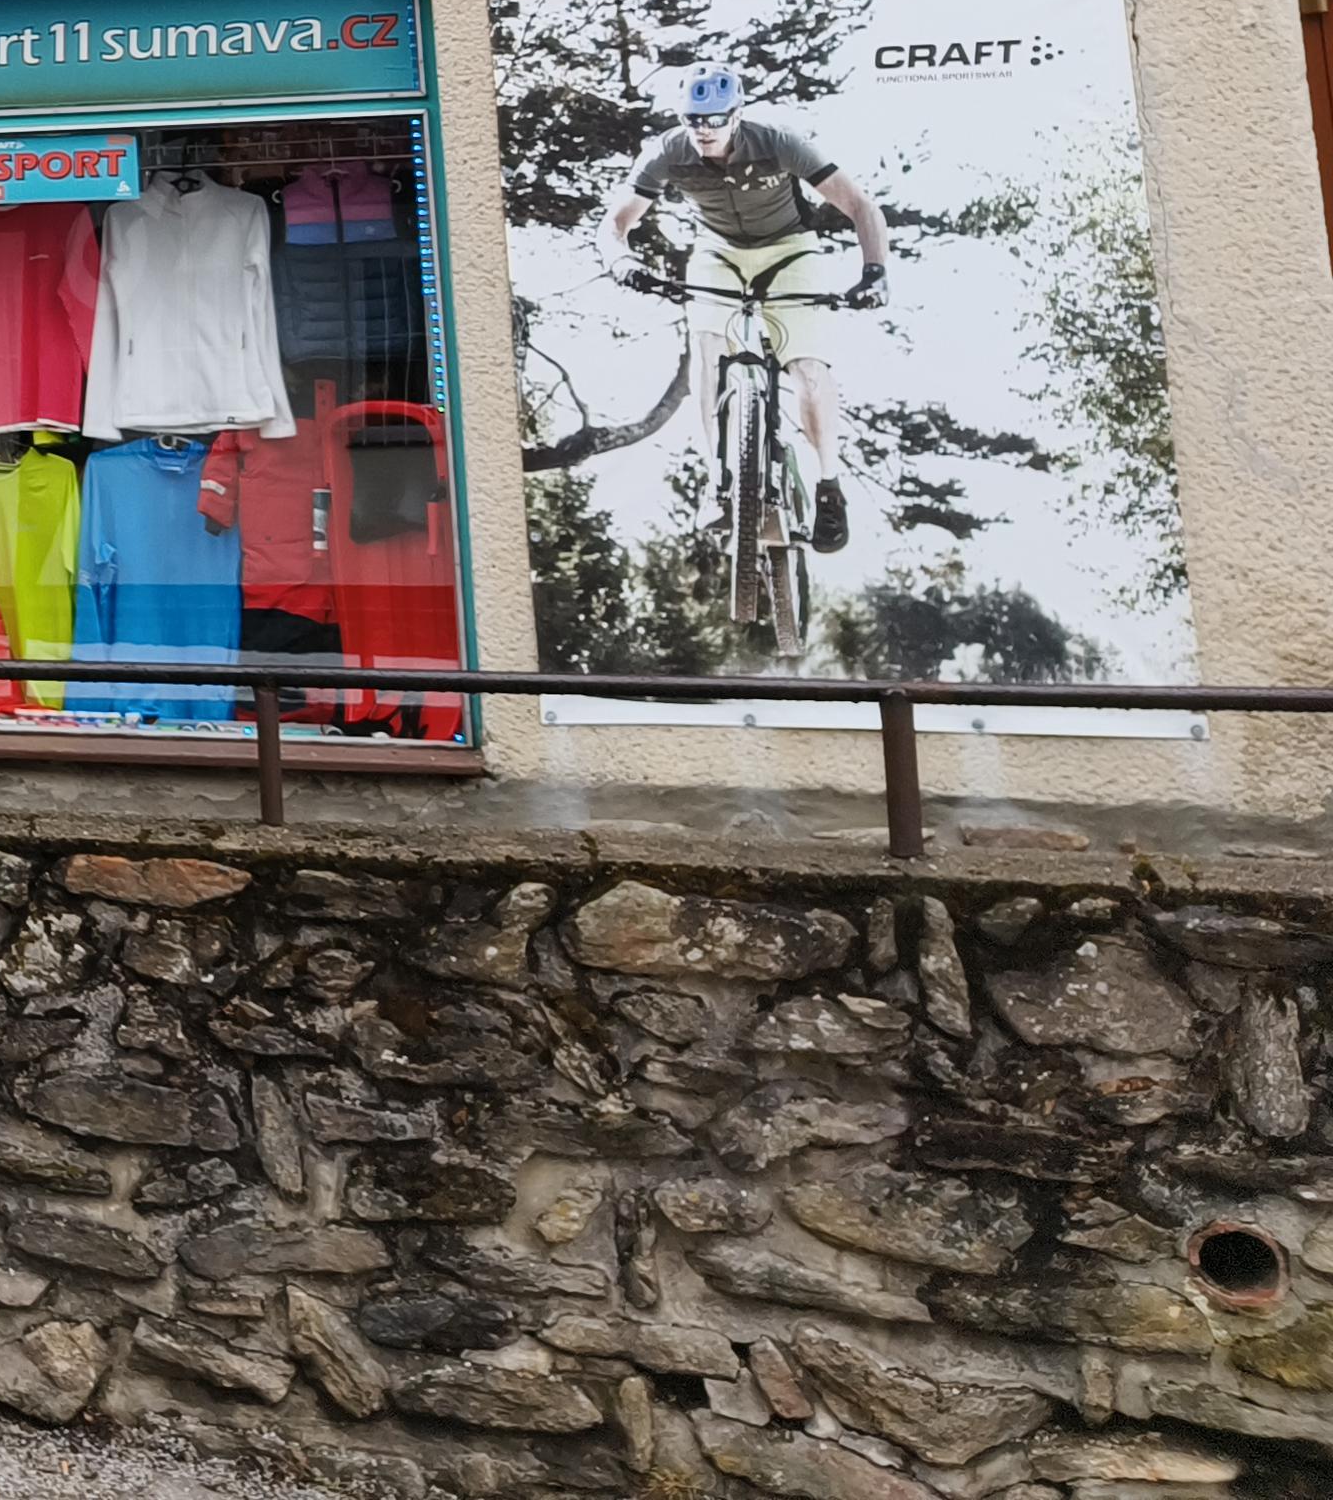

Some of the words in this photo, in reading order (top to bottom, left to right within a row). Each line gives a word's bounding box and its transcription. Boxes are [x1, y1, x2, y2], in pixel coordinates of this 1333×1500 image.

[874, 39, 1023, 70] CRAFT
[876, 73, 938, 85] FUNCTIONAL
[941, 70, 1013, 82] SPORTSWEAR
